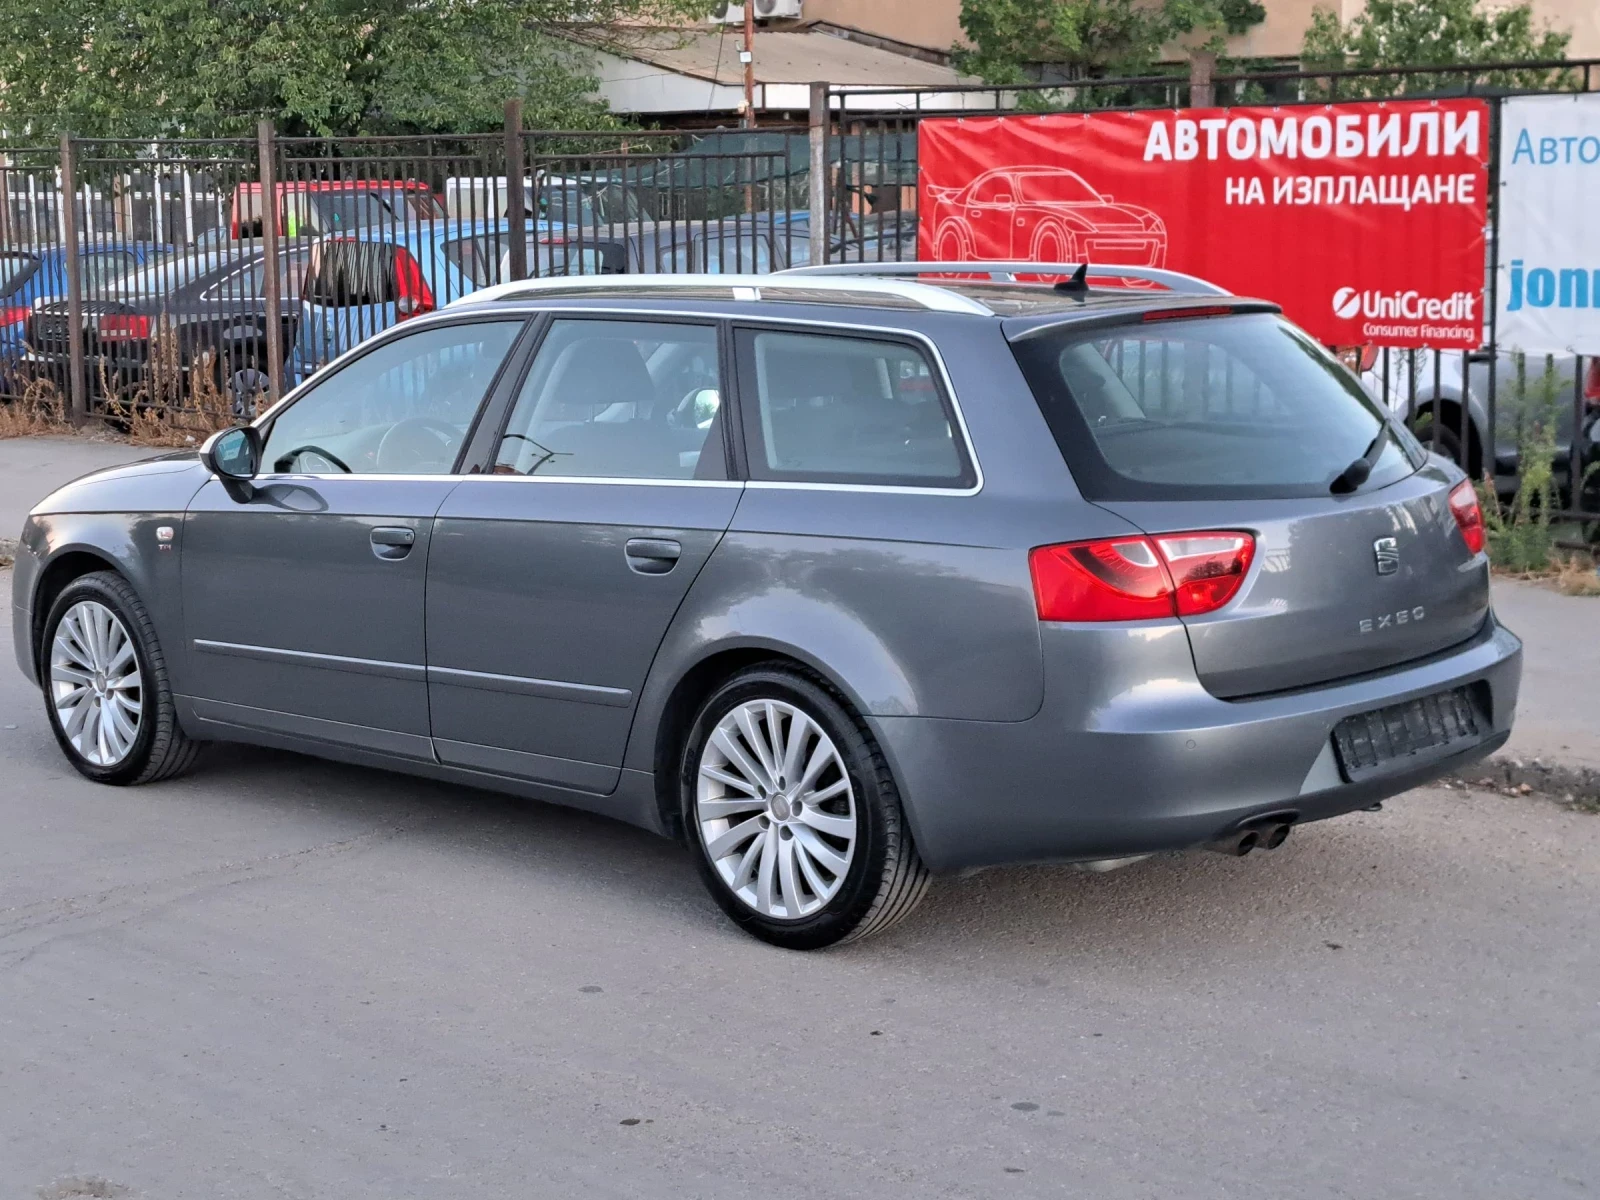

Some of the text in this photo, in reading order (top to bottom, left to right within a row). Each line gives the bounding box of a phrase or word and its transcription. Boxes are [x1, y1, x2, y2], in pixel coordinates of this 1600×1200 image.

[1144, 111, 1480, 160] АВТОМОБИЛИ
[1226, 174, 1476, 211] НА ИЗПЛАЩАНЕ
[1506, 259, 1600, 311] jon
[1363, 289, 1475, 321] UniCredit
[1363, 322, 1475, 342] Consumer Financing
[1359, 605, 1425, 633] EXEO
